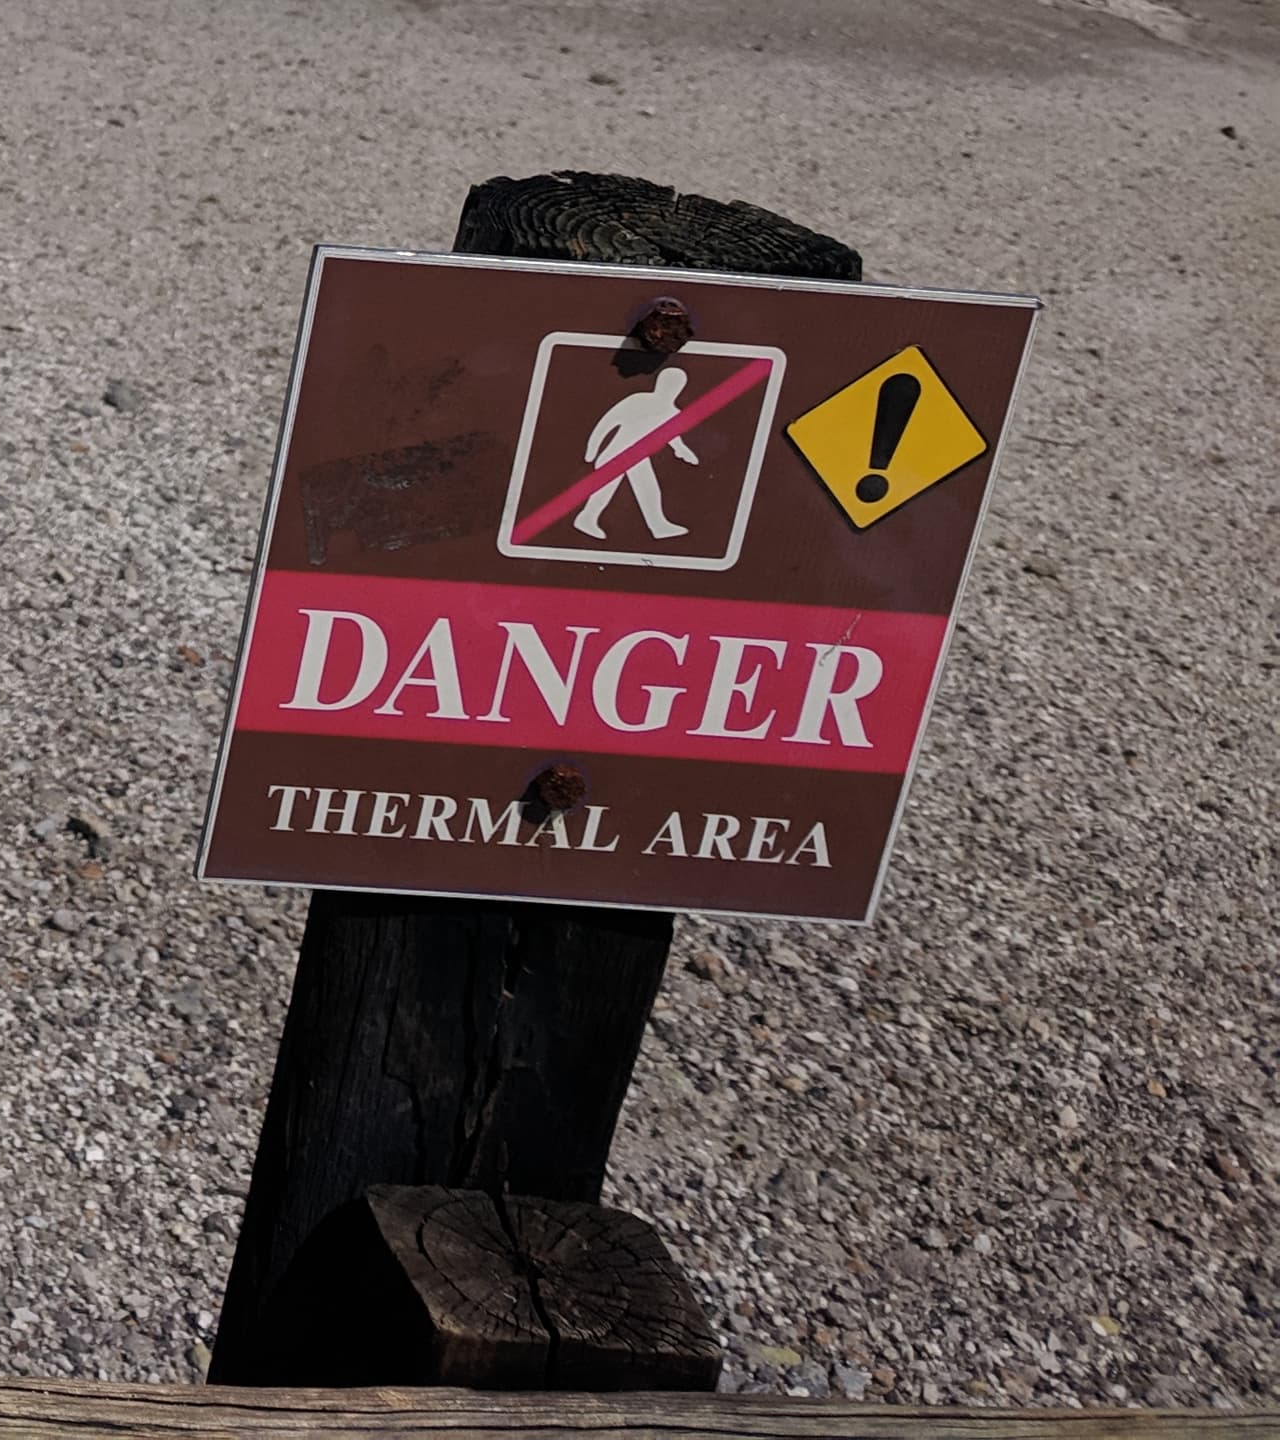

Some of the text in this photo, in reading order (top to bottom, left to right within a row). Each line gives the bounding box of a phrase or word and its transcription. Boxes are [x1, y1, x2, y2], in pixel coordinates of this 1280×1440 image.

[279, 608, 883, 748] DANGER
[266, 783, 832, 869] THERMAL AREA
